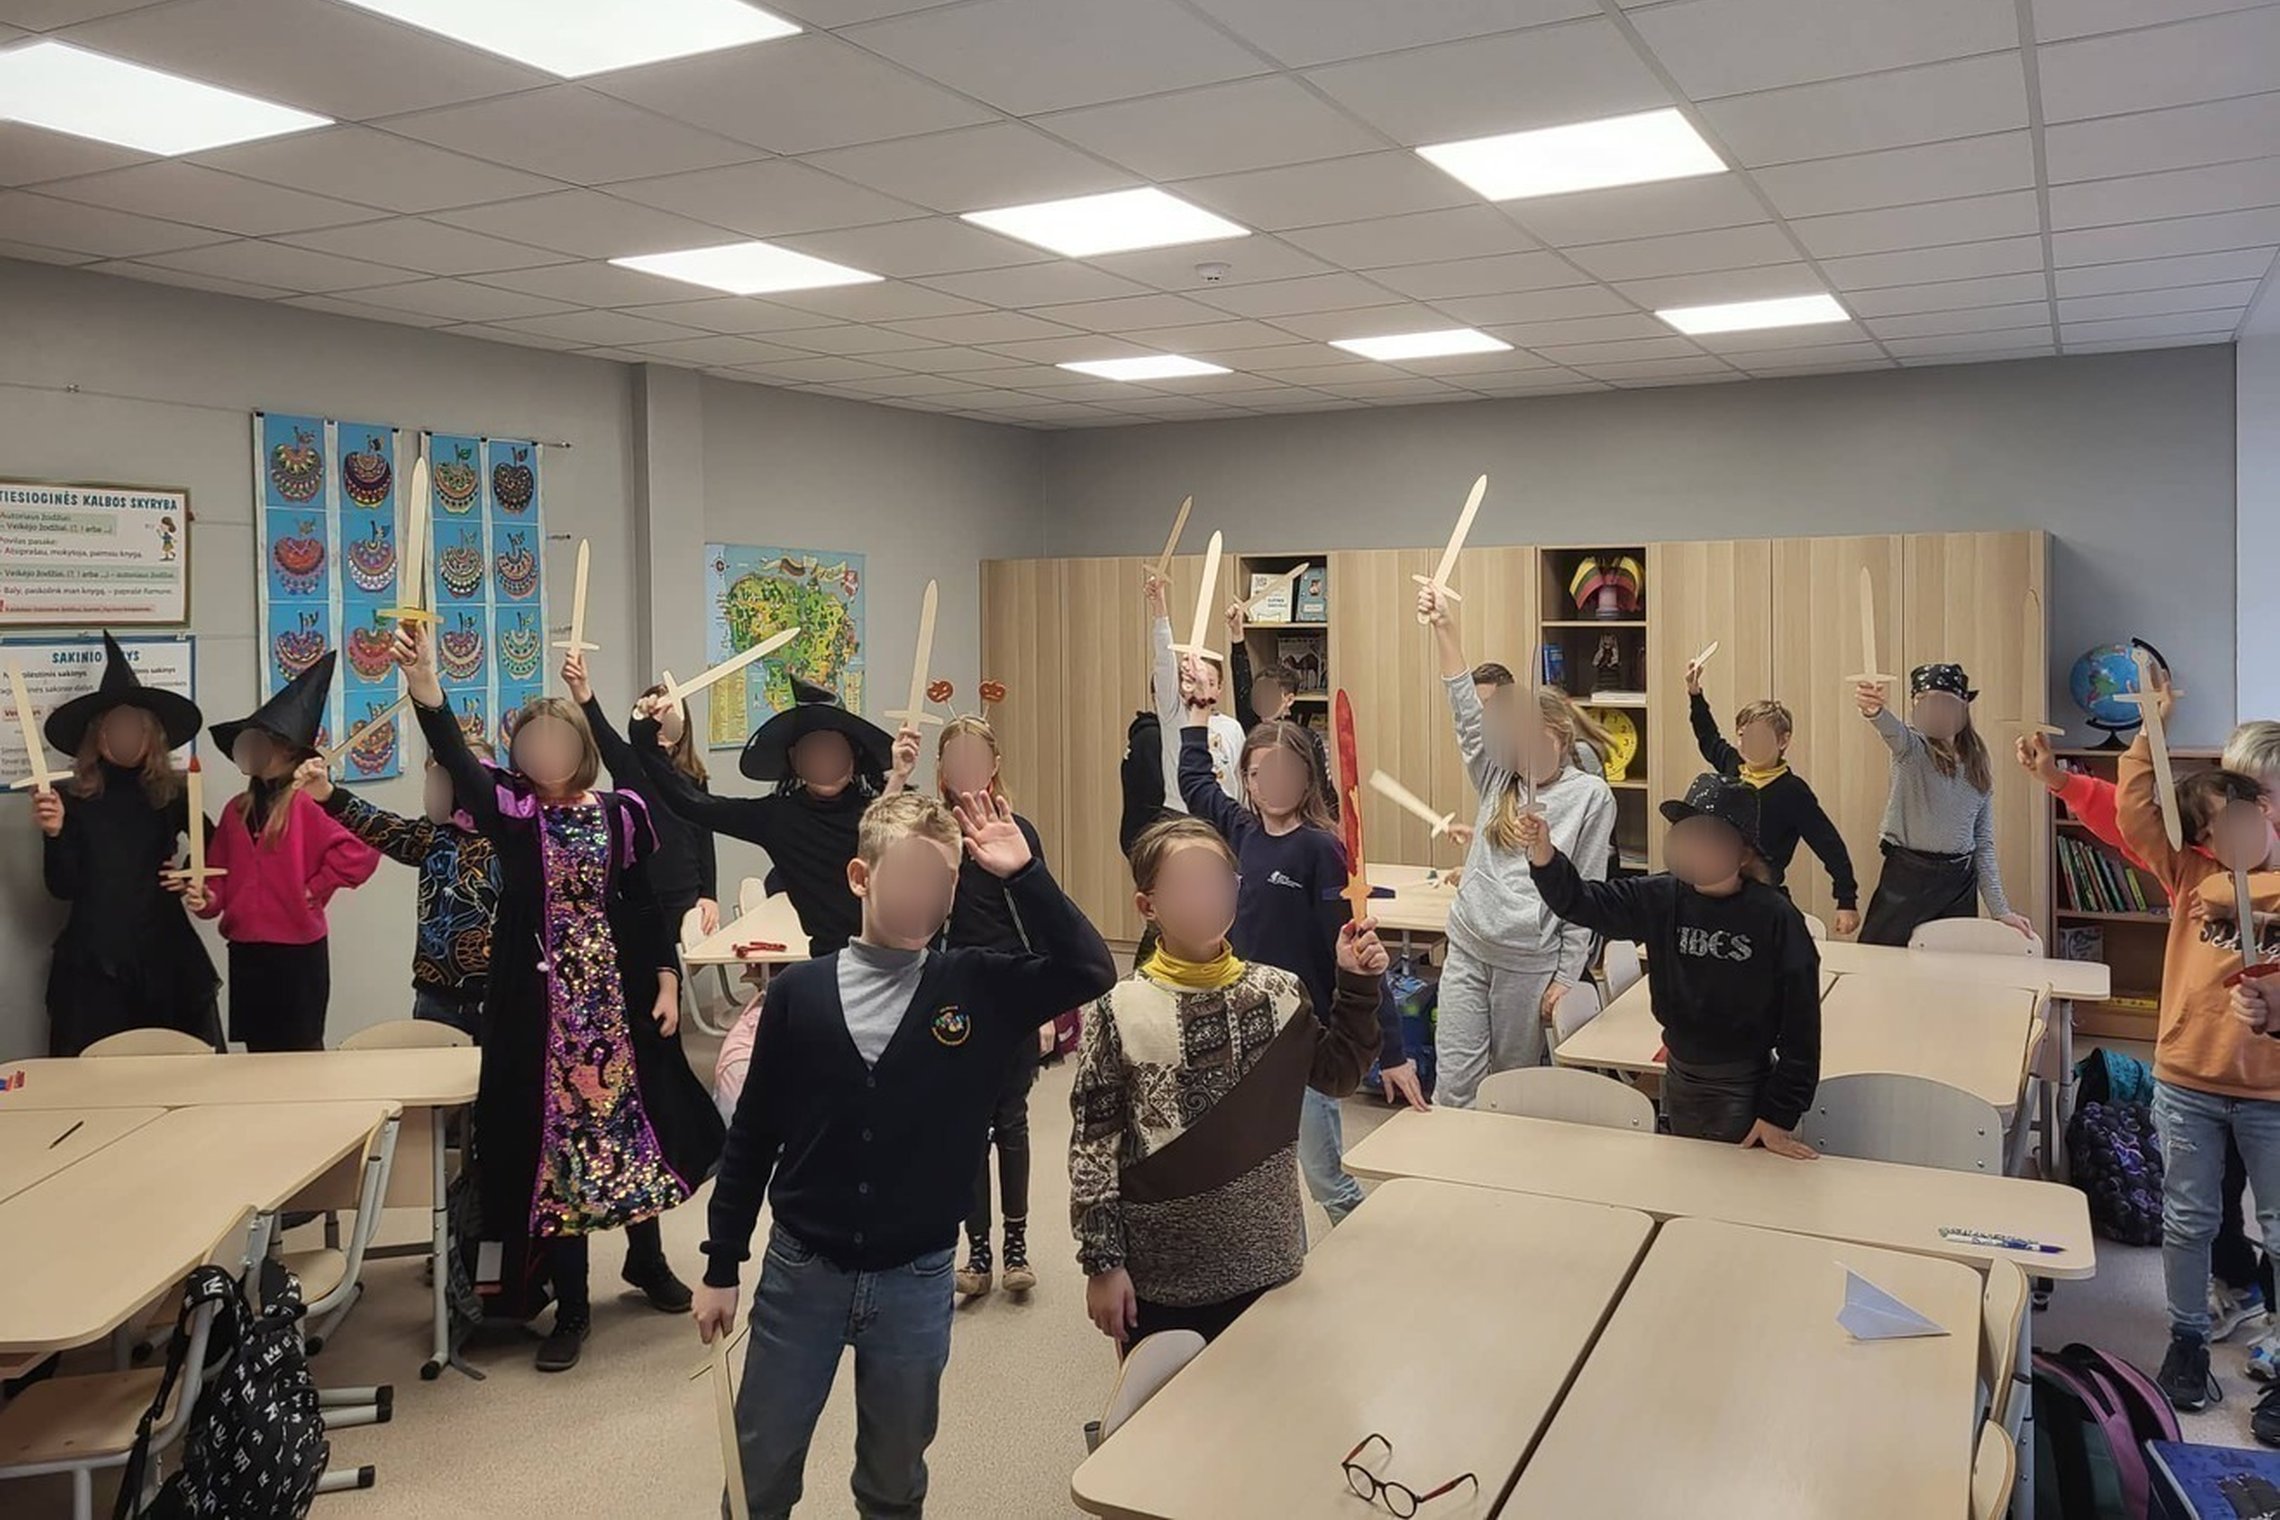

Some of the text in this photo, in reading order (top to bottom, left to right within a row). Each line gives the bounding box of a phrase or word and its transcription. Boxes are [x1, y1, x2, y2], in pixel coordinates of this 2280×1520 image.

[82, 494, 127, 508] KALBOS
[130, 497, 178, 511] SKYRYBA
[52, 651, 102, 664] SAKINIO
